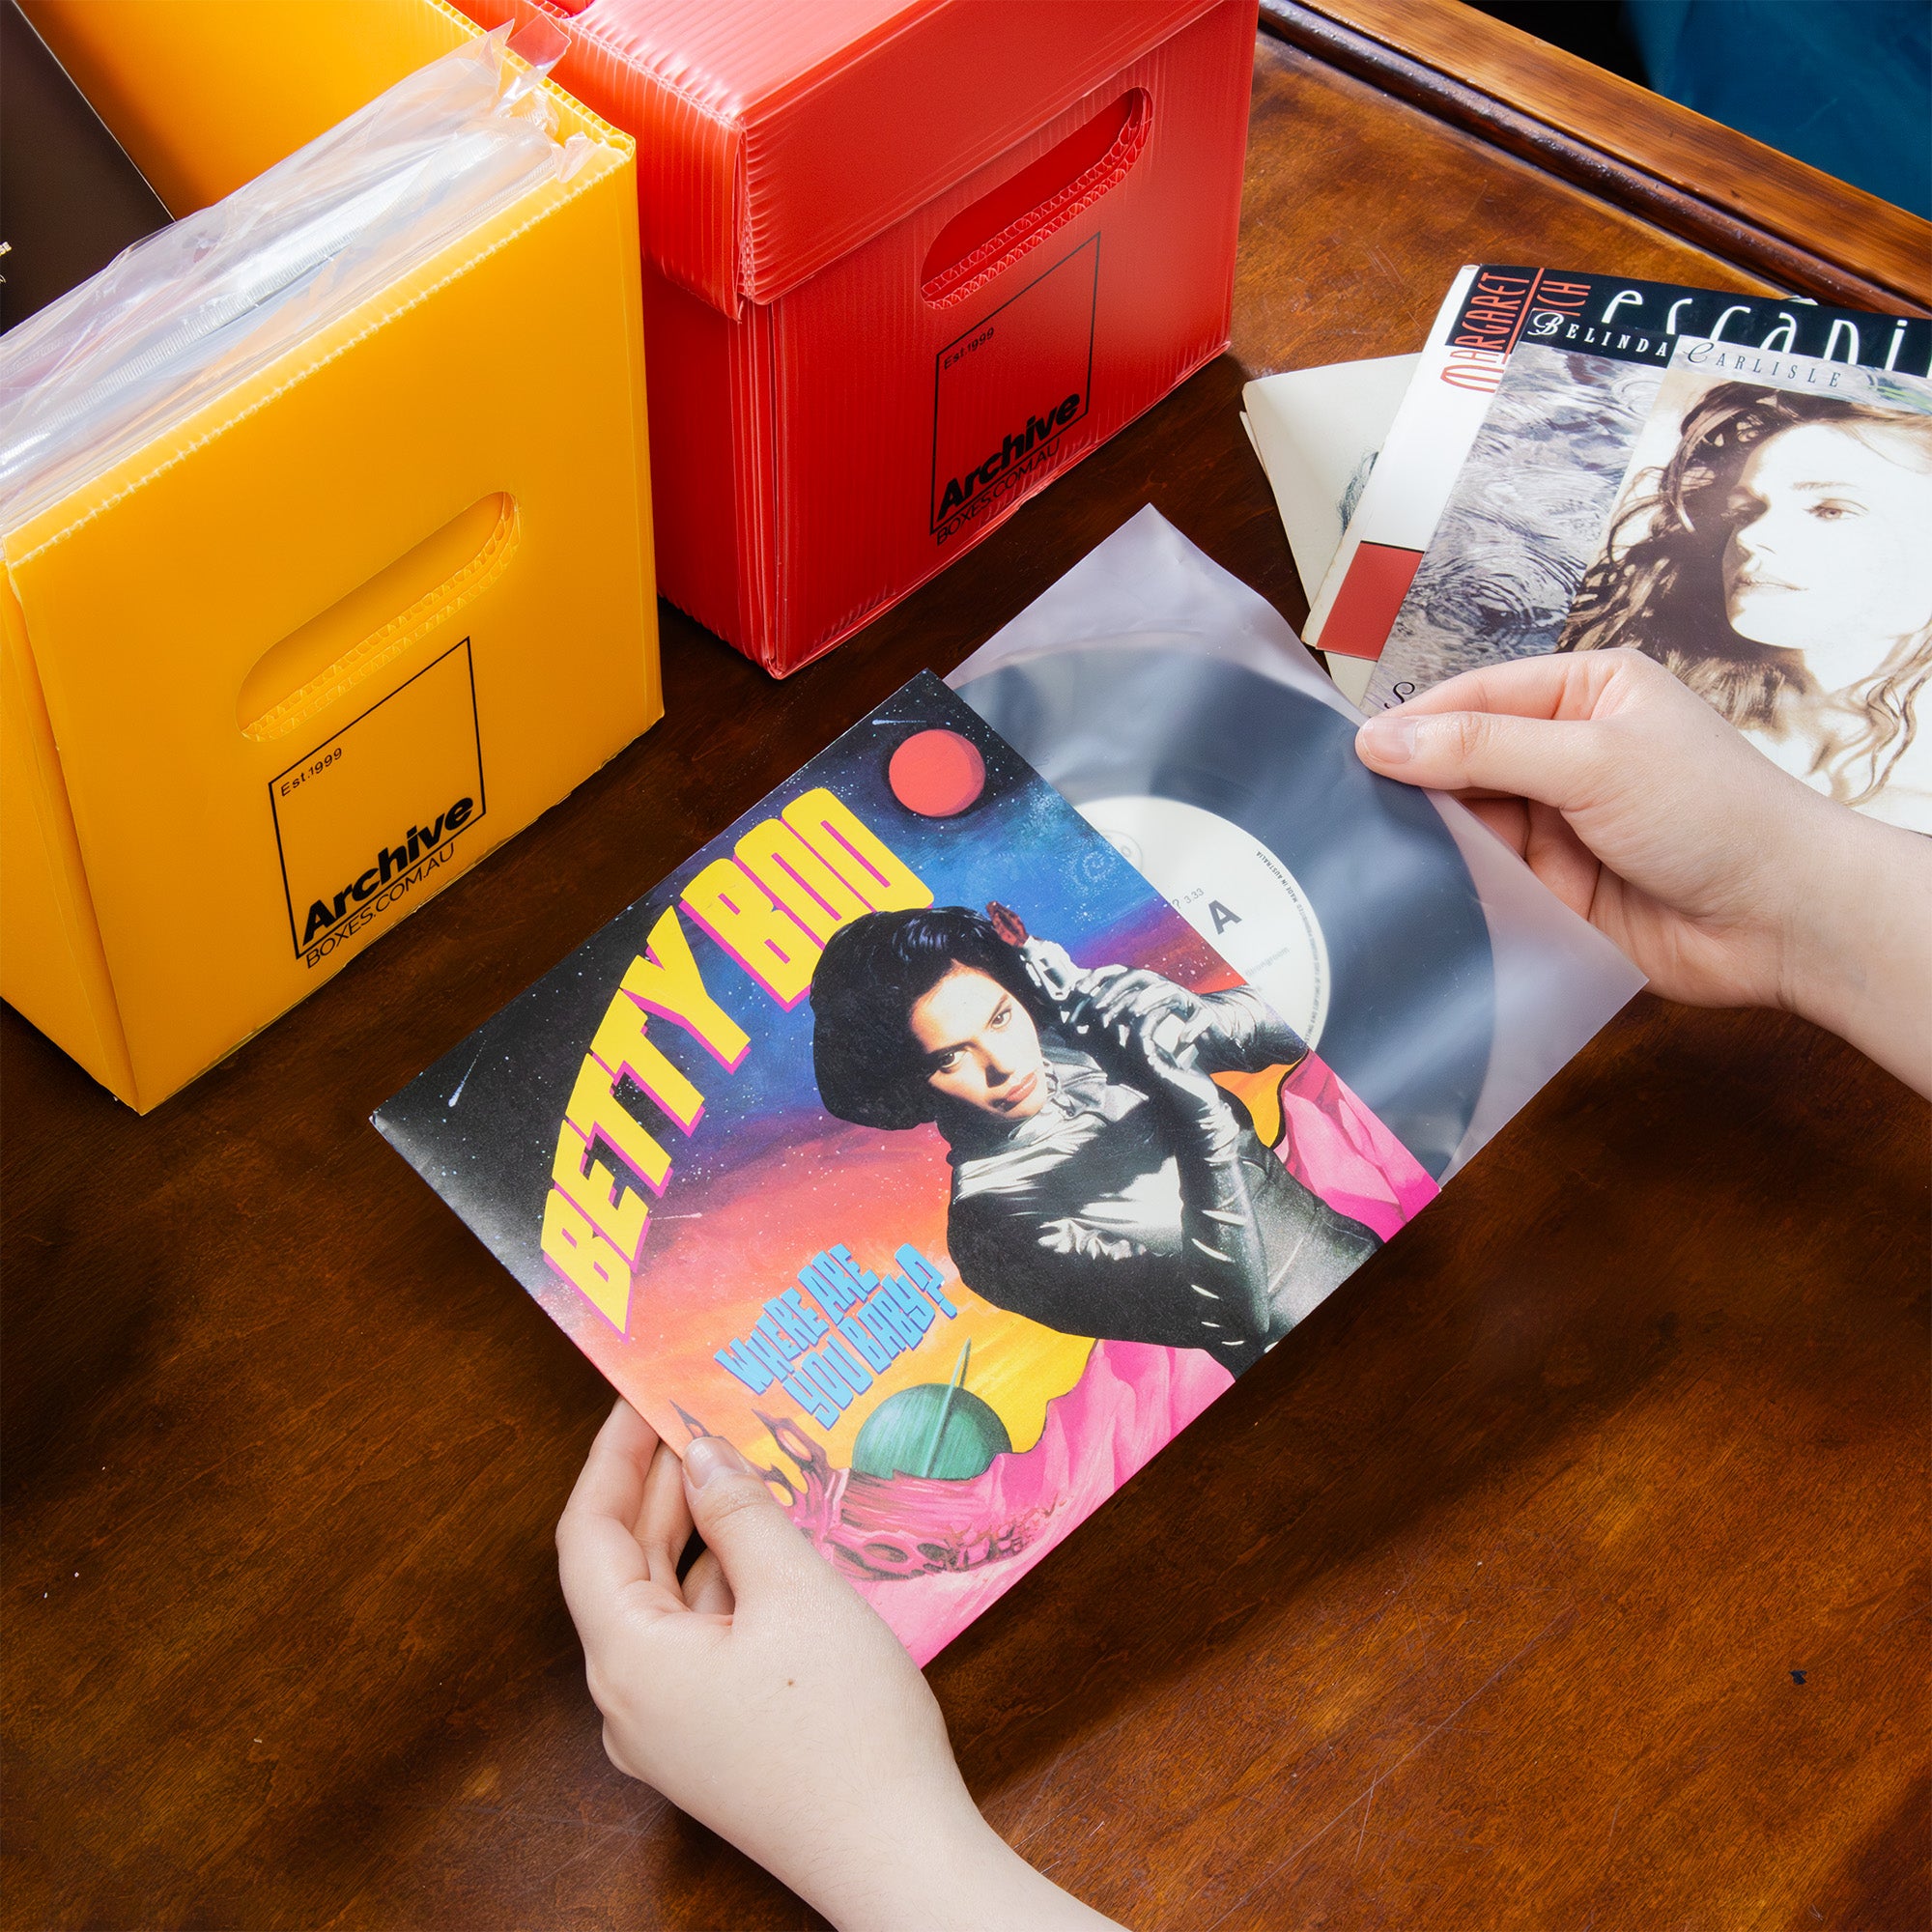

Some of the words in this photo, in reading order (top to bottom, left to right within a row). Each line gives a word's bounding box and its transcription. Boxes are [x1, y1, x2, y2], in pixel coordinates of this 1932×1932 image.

[1440, 272, 1530, 393] MARGARET
[1527, 311, 1667, 357] BELINDA
[1682, 342, 1841, 387] CARLISLE
[936, 393, 1081, 523] Archive
[280, 748, 343, 798] Est.1999
[301, 797, 474, 947] Archive
[305, 841, 455, 969] BOXES.COM.AU
[1208, 899, 1243, 935] A
[1256, 850, 1283, 879] AUSTRALIA
[541, 905, 752, 1343] BETTY
[679, 787, 935, 1011] BOO
[714, 1287, 830, 1396] WHERE
[797, 1243, 880, 1326] ARE
[782, 1334, 874, 1432] YOU
[837, 1242, 958, 1376] BABY?
